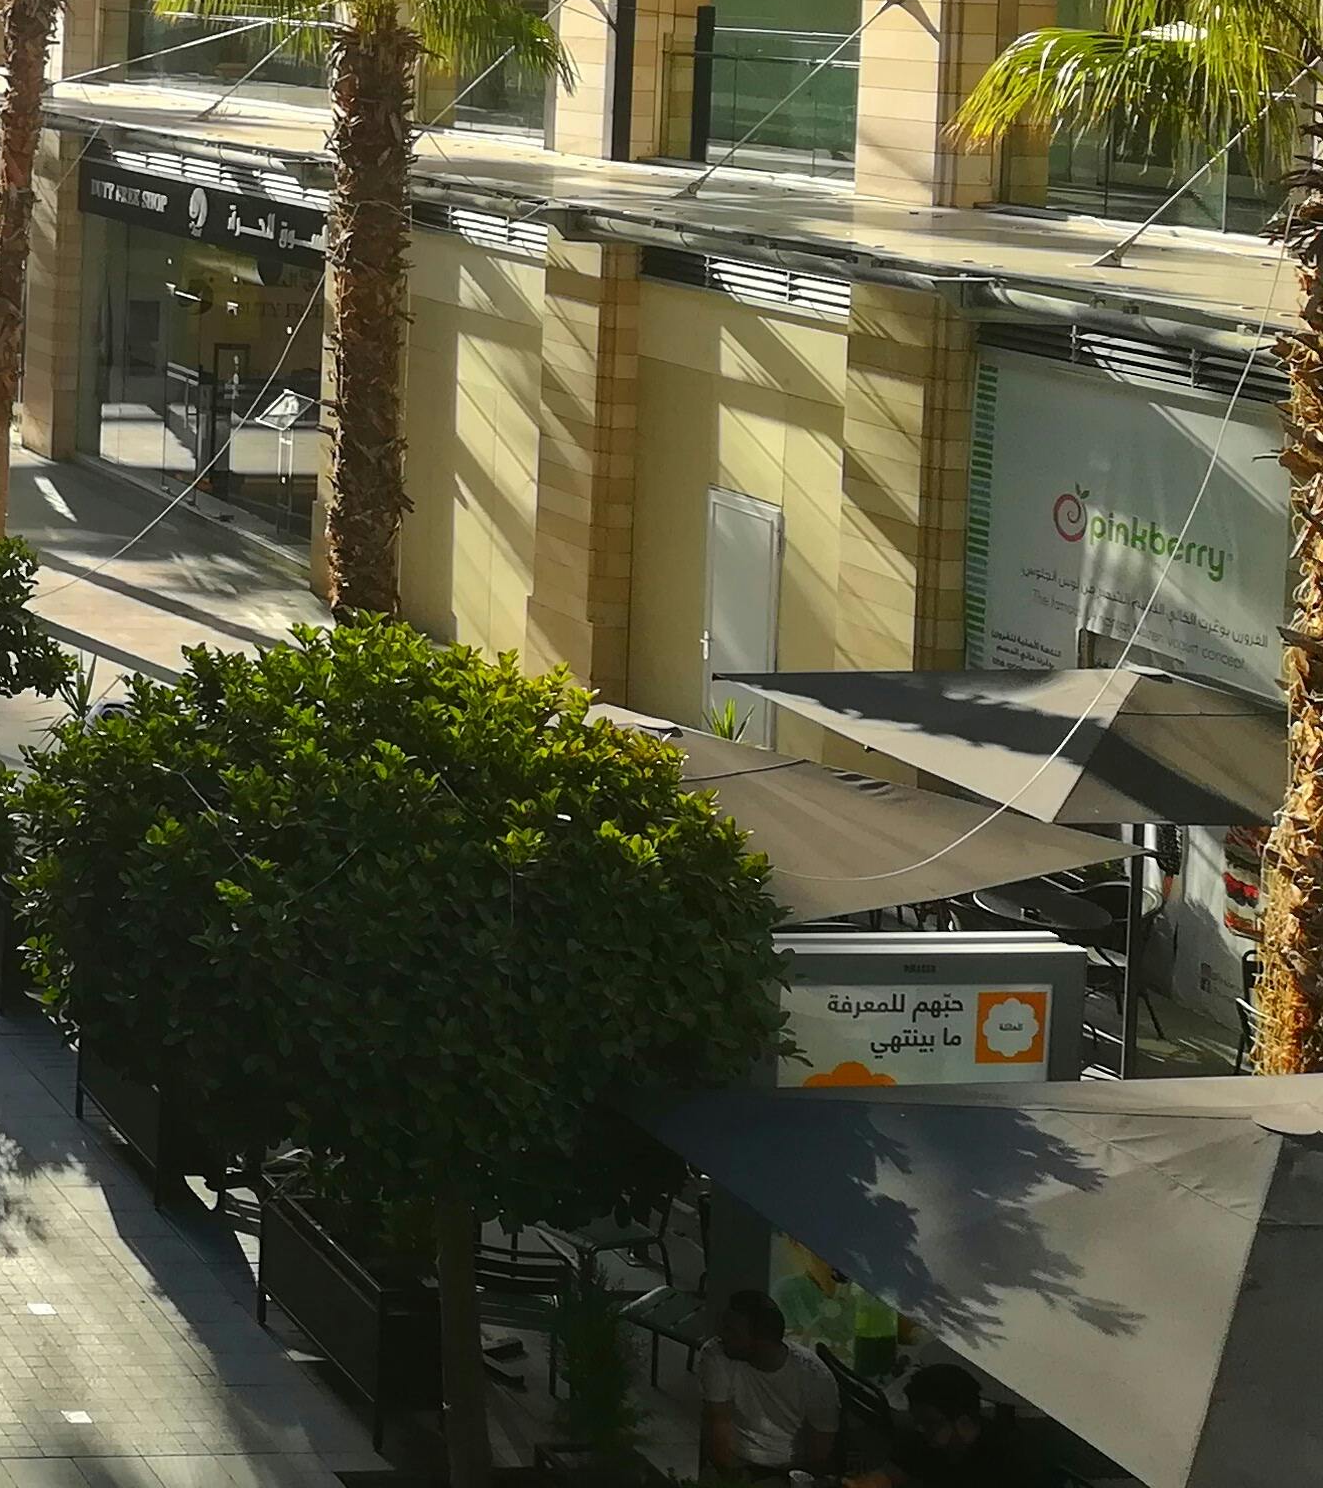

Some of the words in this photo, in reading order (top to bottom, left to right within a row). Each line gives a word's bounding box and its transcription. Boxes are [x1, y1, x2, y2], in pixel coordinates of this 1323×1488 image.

[91, 178, 115, 200] DUTY
[115, 184, 141, 207] FREE
[141, 190, 168, 213] SHOP
[1090, 512, 1225, 582] pinkberry
[827, 993, 906, 1020] للمعرفة
[870, 1029, 935, 1058] بينتهي
[943, 1028, 962, 1047] ما
